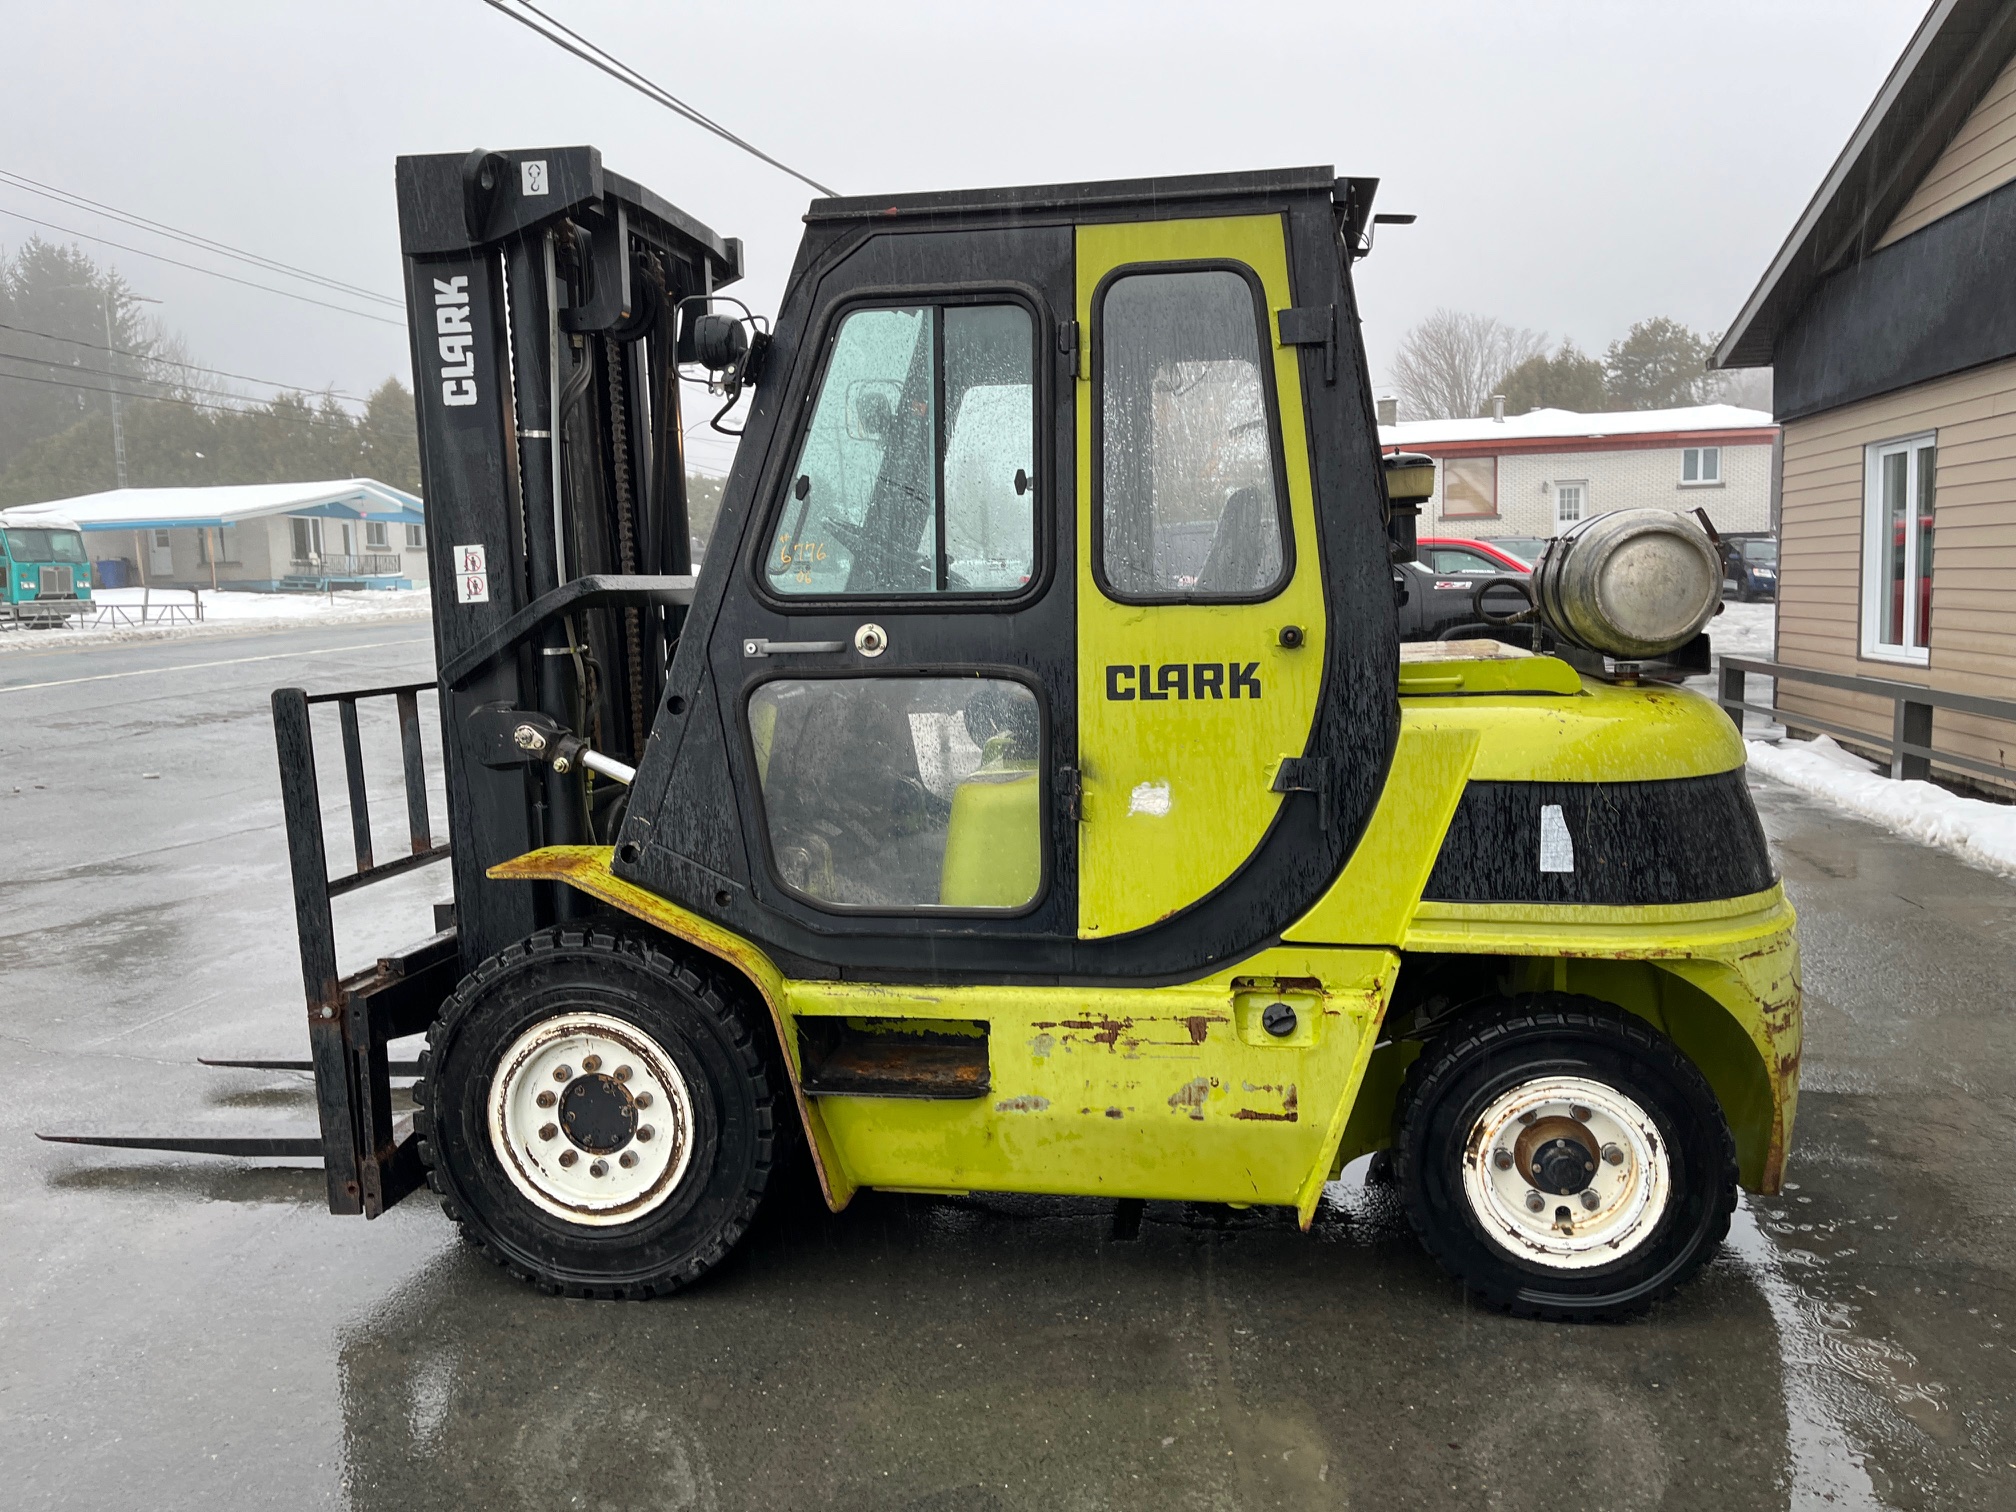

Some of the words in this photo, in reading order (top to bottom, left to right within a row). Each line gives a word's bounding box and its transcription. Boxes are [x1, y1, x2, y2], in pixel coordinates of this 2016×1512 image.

[433, 275, 478, 407] CLARK
[780, 543, 827, 564] 6776
[1106, 662, 1262, 701] CLARK
